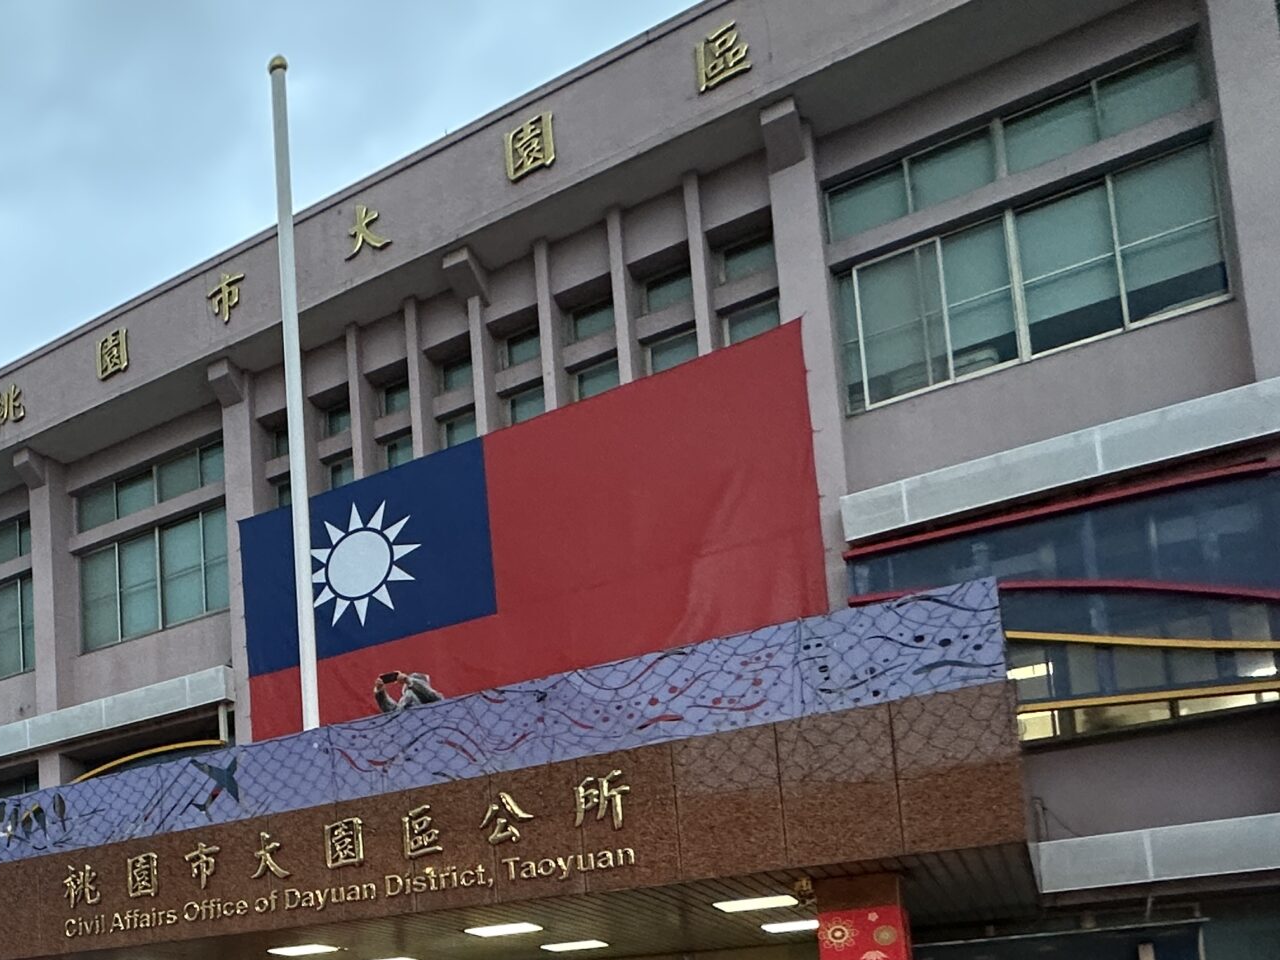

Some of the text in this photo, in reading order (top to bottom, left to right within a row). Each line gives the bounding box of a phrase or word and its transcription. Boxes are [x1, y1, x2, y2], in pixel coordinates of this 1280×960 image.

[63, 769, 631, 908] 桃園市大園區公所
[64, 847, 636, 938] Civil Affairs Office of Dayuan District, Taoyuan
